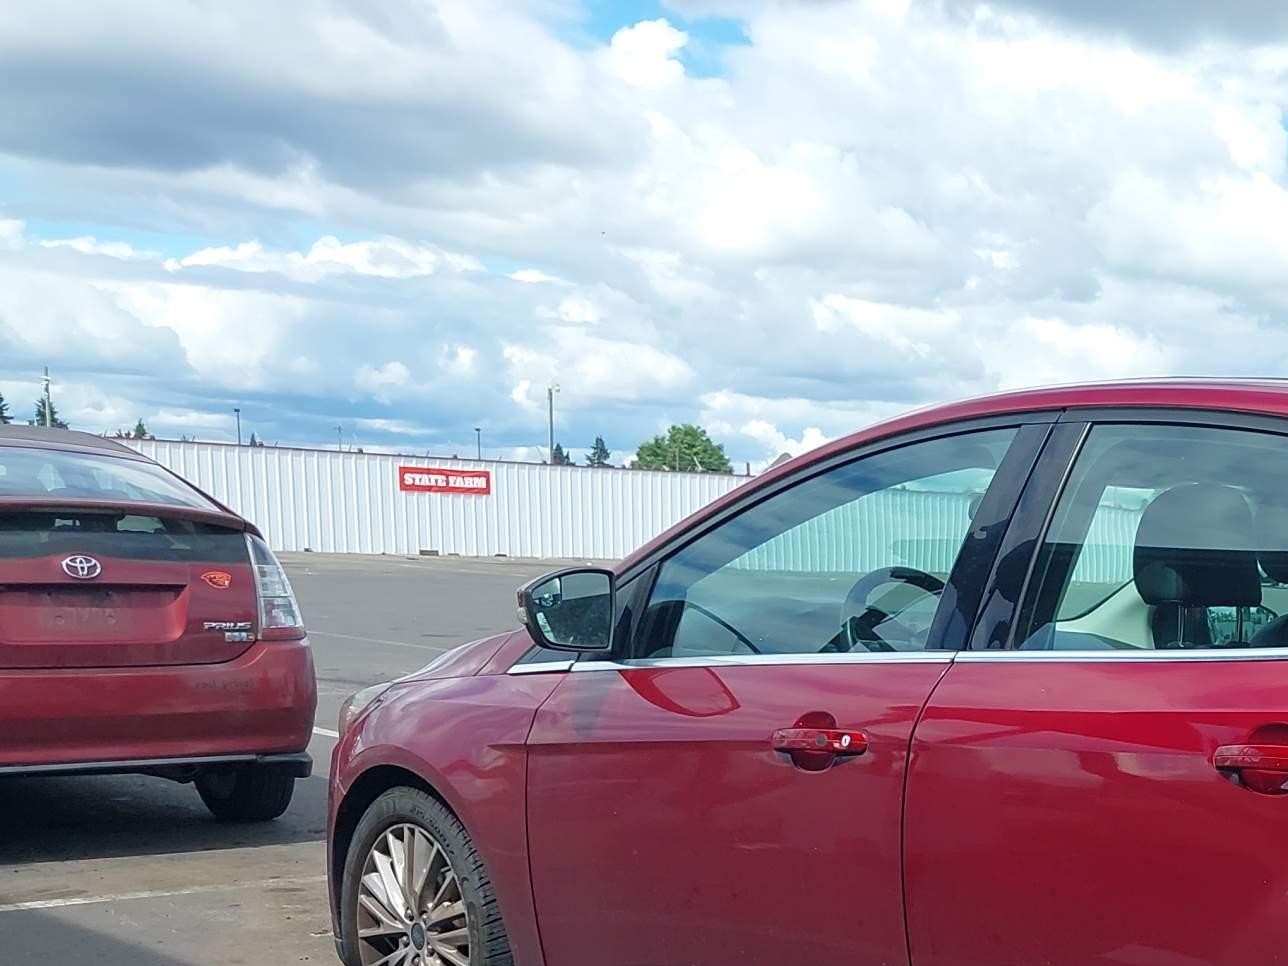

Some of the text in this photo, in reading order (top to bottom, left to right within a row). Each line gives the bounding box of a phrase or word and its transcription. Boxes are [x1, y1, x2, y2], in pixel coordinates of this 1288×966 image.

[404, 473, 487, 488] STATE FARM
[203, 622, 252, 630] PRIUS
